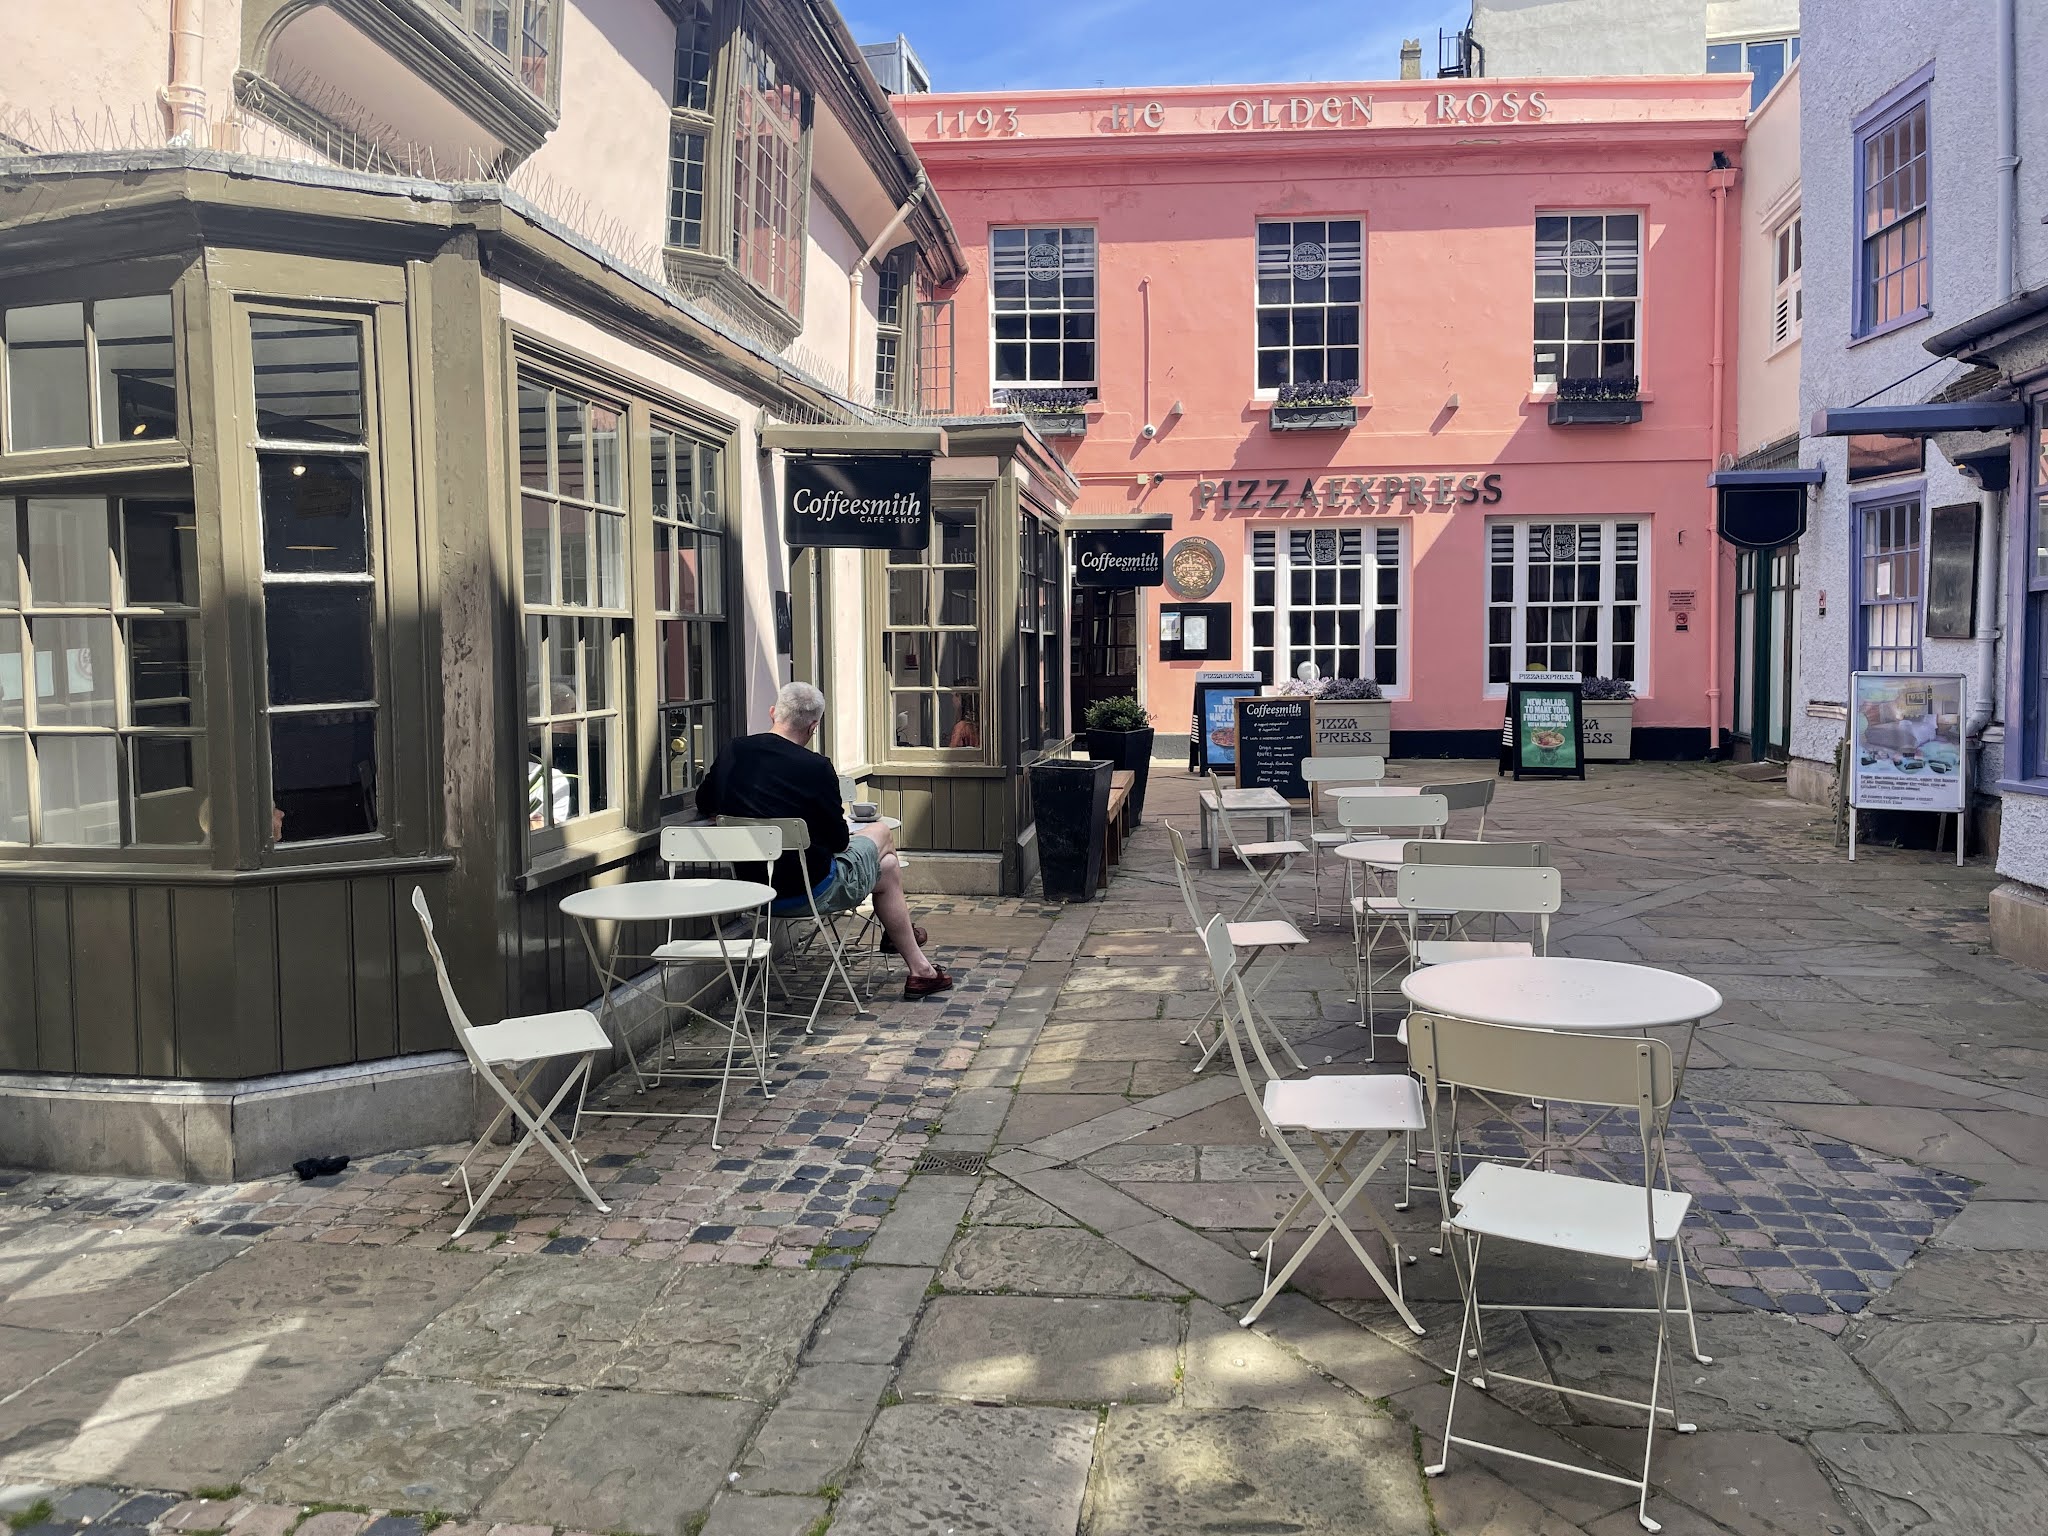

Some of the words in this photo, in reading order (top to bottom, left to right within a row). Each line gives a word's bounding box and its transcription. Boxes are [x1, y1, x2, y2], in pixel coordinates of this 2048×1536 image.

[935, 106, 1018, 134] 1193
[1436, 90, 1548, 120] ROSS
[1198, 474, 1503, 510] PIZZAEXPRESS
[793, 488, 921, 522] Coffeesmith
[894, 516, 921, 524] SHOP
[1081, 551, 1159, 572] Coffeesmith
[1526, 698, 1542, 706] NEW
[1542, 698, 1567, 706] SALADS
[1246, 703, 1302, 718] Coffeesmith
[1524, 706, 1534, 714] TO
[1534, 706, 1553, 714] MAKE
[1553, 706, 1570, 714] YOUR
[1523, 713, 1551, 722] FRIENDS
[1551, 713, 1571, 722] GREEN
[1315, 731, 1372, 743] PRESS
